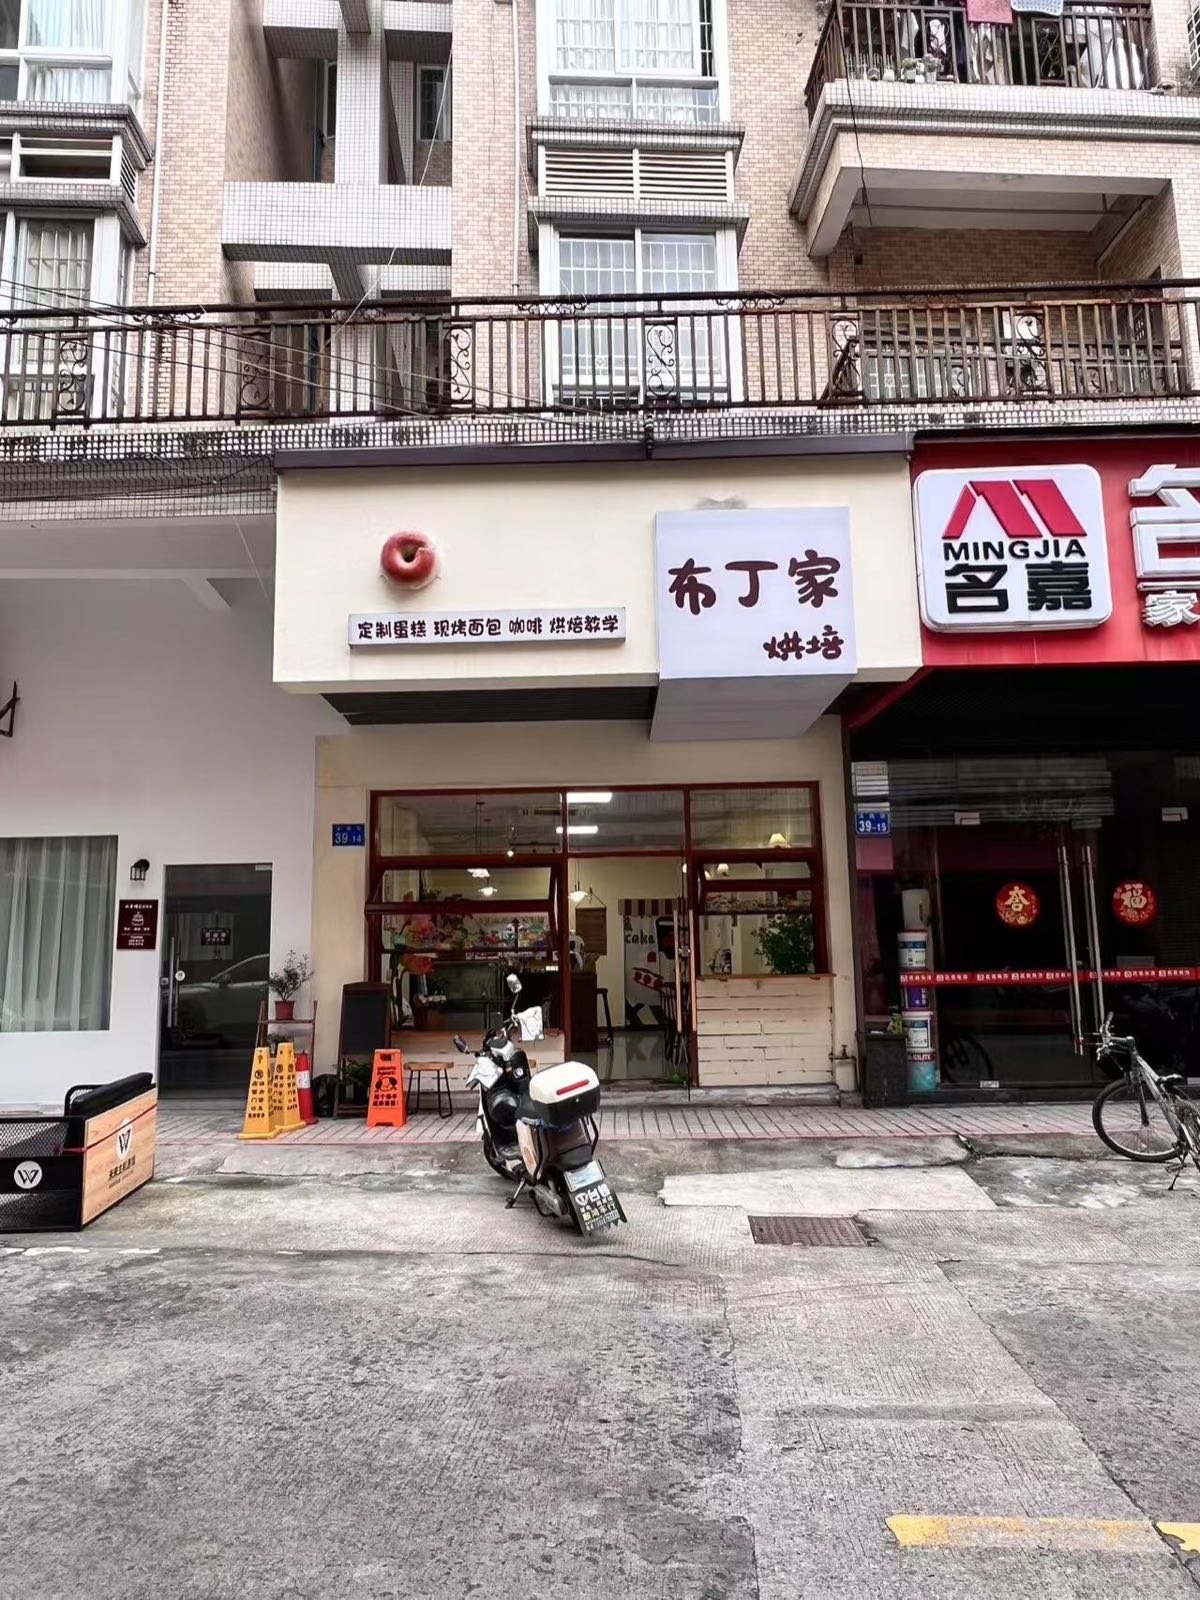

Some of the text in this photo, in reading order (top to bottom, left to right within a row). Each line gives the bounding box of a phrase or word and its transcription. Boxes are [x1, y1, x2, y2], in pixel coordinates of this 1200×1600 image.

[943, 539, 1086, 561] MINGJIA
[668, 549, 841, 615] 布丁家
[944, 561, 1092, 614] 名嘉
[358, 615, 619, 639] 定制蛋糕 现烤面包 咖啡 烘焙教学
